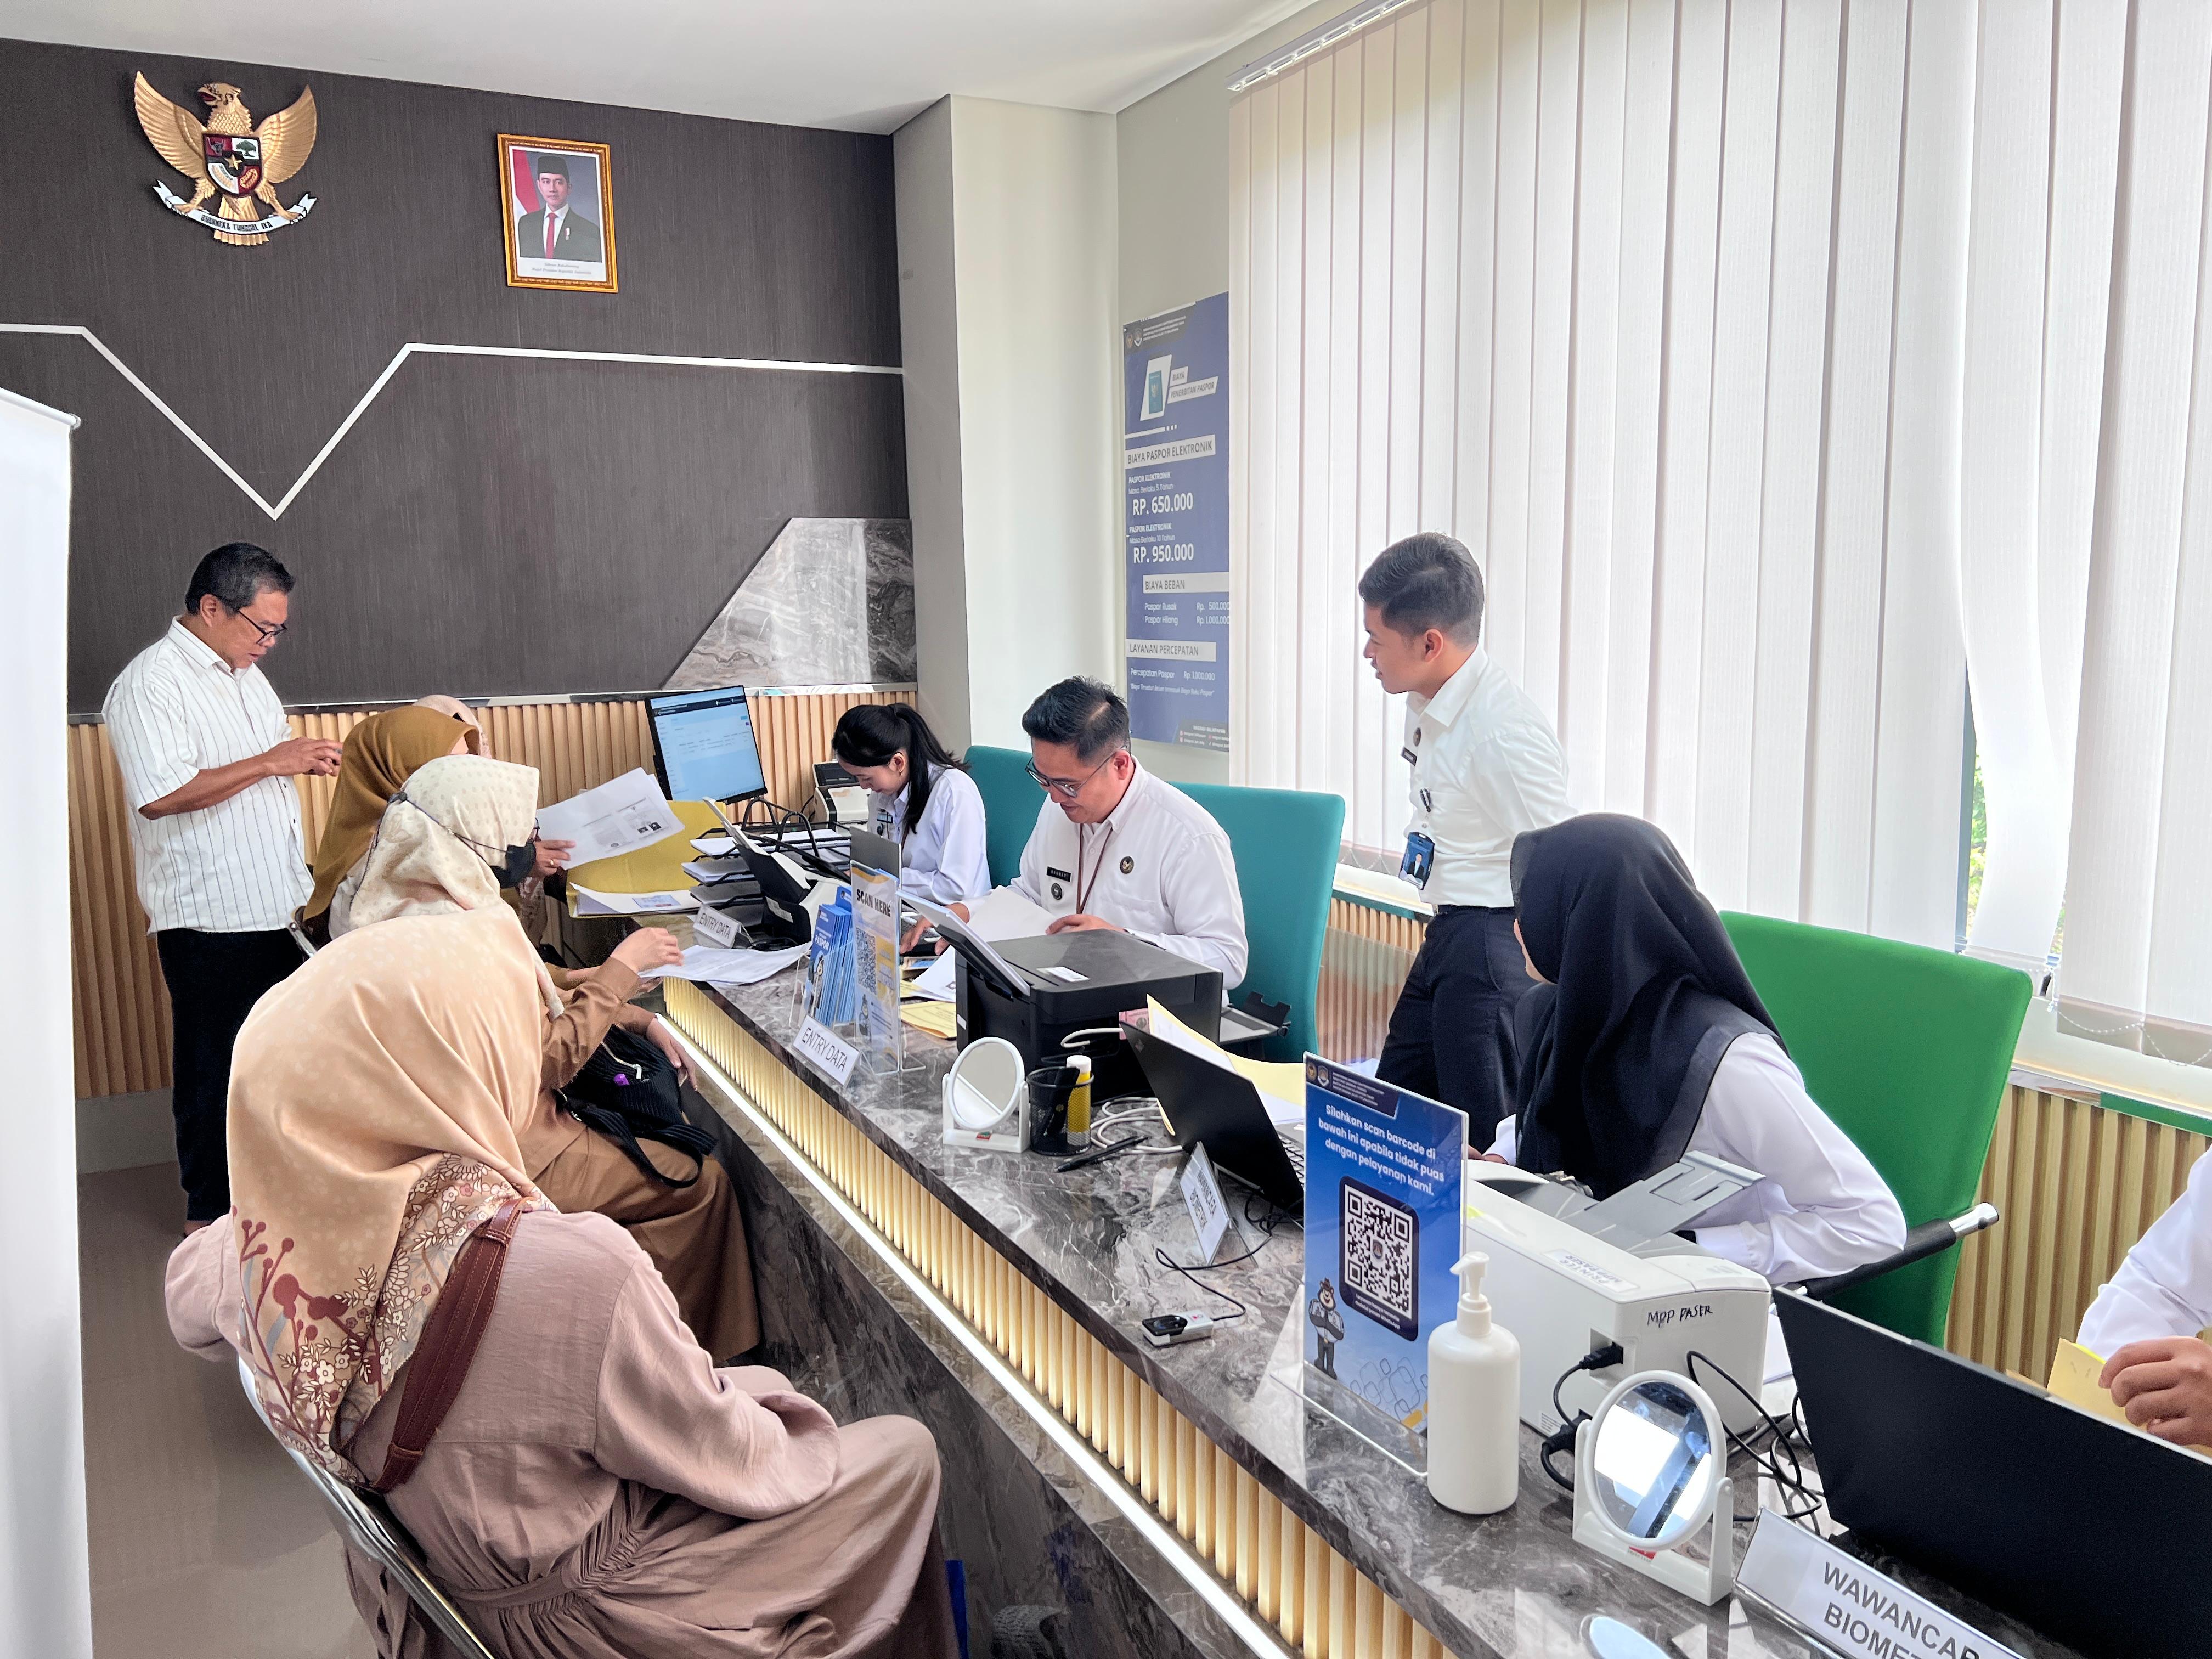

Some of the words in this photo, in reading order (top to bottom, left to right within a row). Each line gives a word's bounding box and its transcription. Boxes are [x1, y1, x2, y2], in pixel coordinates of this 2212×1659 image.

[261, 221, 273, 230] IKA
[1197, 382, 1214, 392] PASPOR
[1128, 452, 1146, 464] BIAYA
[1147, 448, 1171, 461] PASPOR
[1172, 440, 1212, 456] ELEKTRONIK
[1128, 475, 1145, 484] PASPOR
[1145, 471, 1171, 482] ELEKTRONIK
[1132, 498, 1149, 516] RP.
[1152, 492, 1193, 514] 650.000
[1146, 522, 1172, 532] ELEKTRONIK
[1133, 546, 1150, 563] RP.
[1152, 543, 1194, 562] 950.000
[1145, 581, 1163, 590] BIAYA
[1164, 580, 1185, 589] BEBAN
[1144, 603, 1161, 612] Paspor
[1197, 602, 1205, 612] Rp.
[1144, 616, 1161, 625] Paspor
[1162, 616, 1178, 627] Hilang
[1197, 616, 1205, 626] Rp.
[1130, 644, 1158, 653] LAYANAN
[1159, 645, 1199, 656] PERCEPATAN
[1130, 668, 1158, 678] Percepatan
[1158, 670, 1175, 680] Paspor
[1192, 671, 1215, 680] 1.000.000
[856, 889, 873, 909] SCAN
[874, 896, 891, 917] HERE
[699, 912, 718, 931] ENTRY
[716, 921, 731, 939] DATA
[802, 1027, 830, 1056] ENTRY
[825, 1045, 848, 1071] DATA
[1325, 1104, 1362, 1128] Silahkan
[1364, 1122, 1385, 1139] scan
[1386, 1130, 1425, 1155] barcode
[1426, 1148, 1436, 1160] di
[1318, 1116, 1347, 1139] bawah
[1348, 1129, 1359, 1144] ini
[1359, 1138, 1393, 1160] apabila
[1395, 1150, 1419, 1171] tidak
[1420, 1164, 1444, 1182] puas
[1325, 1138, 1357, 1159] dengan
[1358, 1154, 1406, 1184] pelayanan
[1407, 1174, 1435, 1196] kami.
[1565, 1255, 1600, 1271] PASER
[1647, 1310, 1675, 1328] MPP
[1679, 1304, 1713, 1322] PASER
